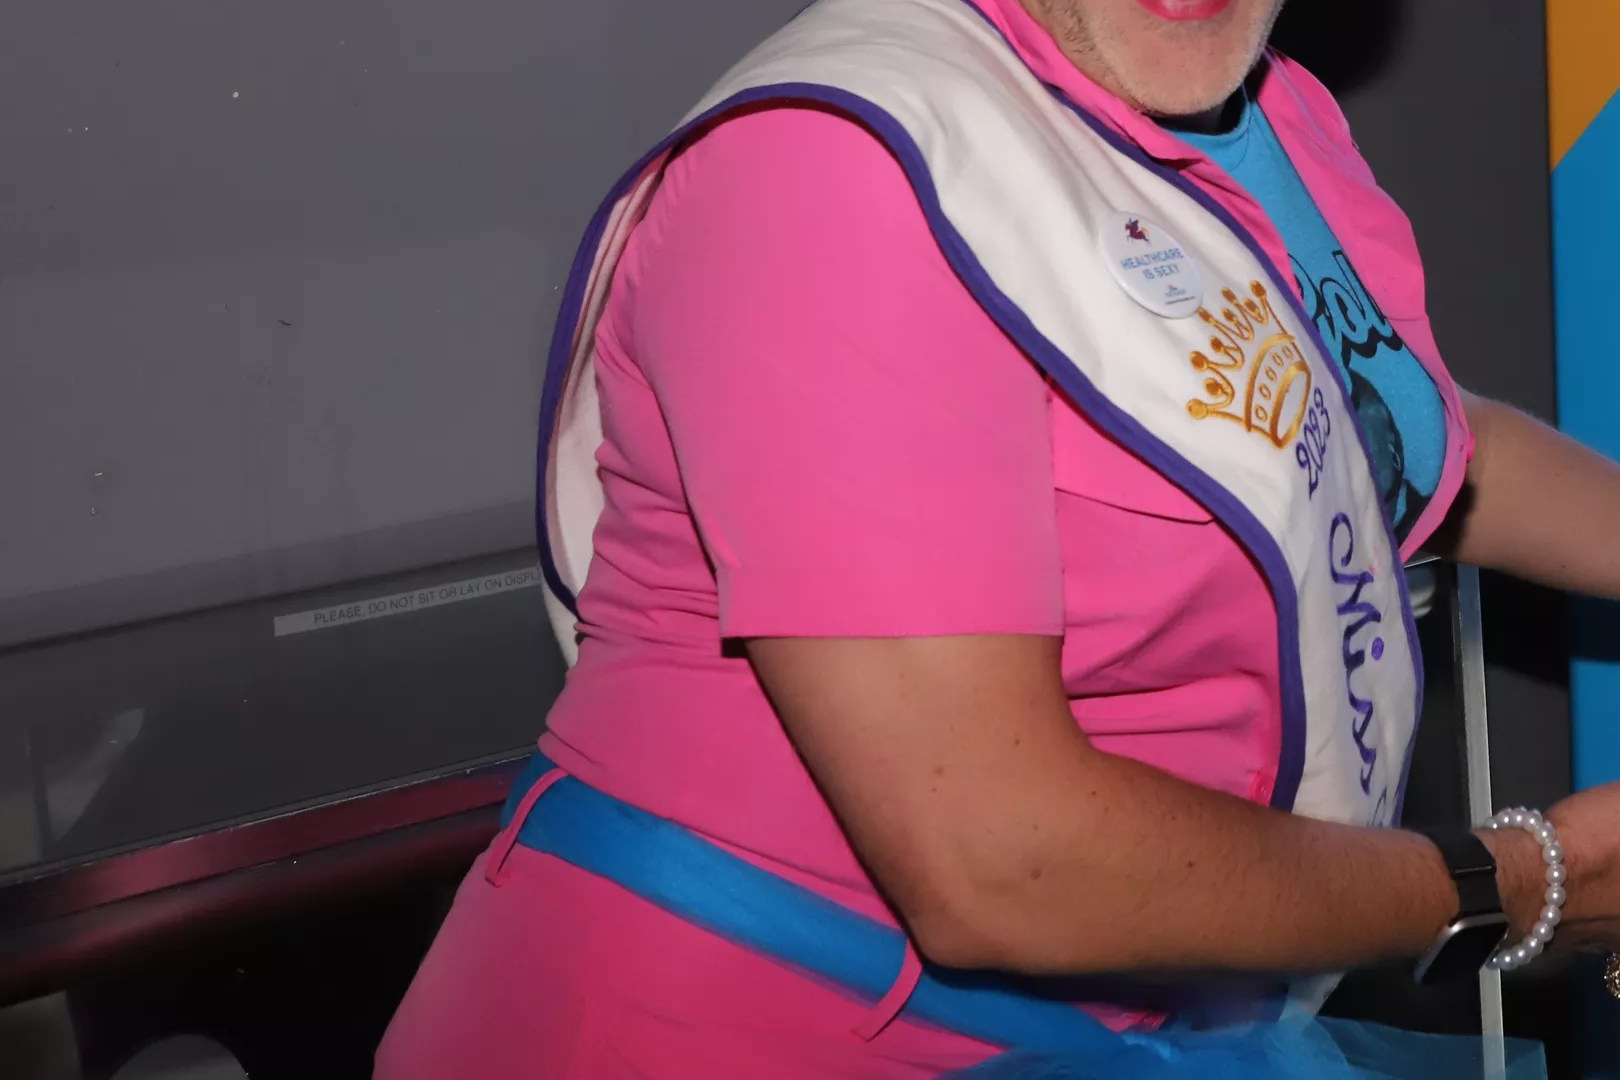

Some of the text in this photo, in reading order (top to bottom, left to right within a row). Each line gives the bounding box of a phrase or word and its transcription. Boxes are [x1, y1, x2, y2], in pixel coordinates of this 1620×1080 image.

[1296, 387, 1332, 499] 2023
[368, 601, 387, 615] DO
[390, 594, 414, 609] NOT
[418, 590, 436, 605] SIT
[439, 586, 457, 600] OR
[460, 581, 481, 596] LAY
[484, 576, 502, 590] ON
